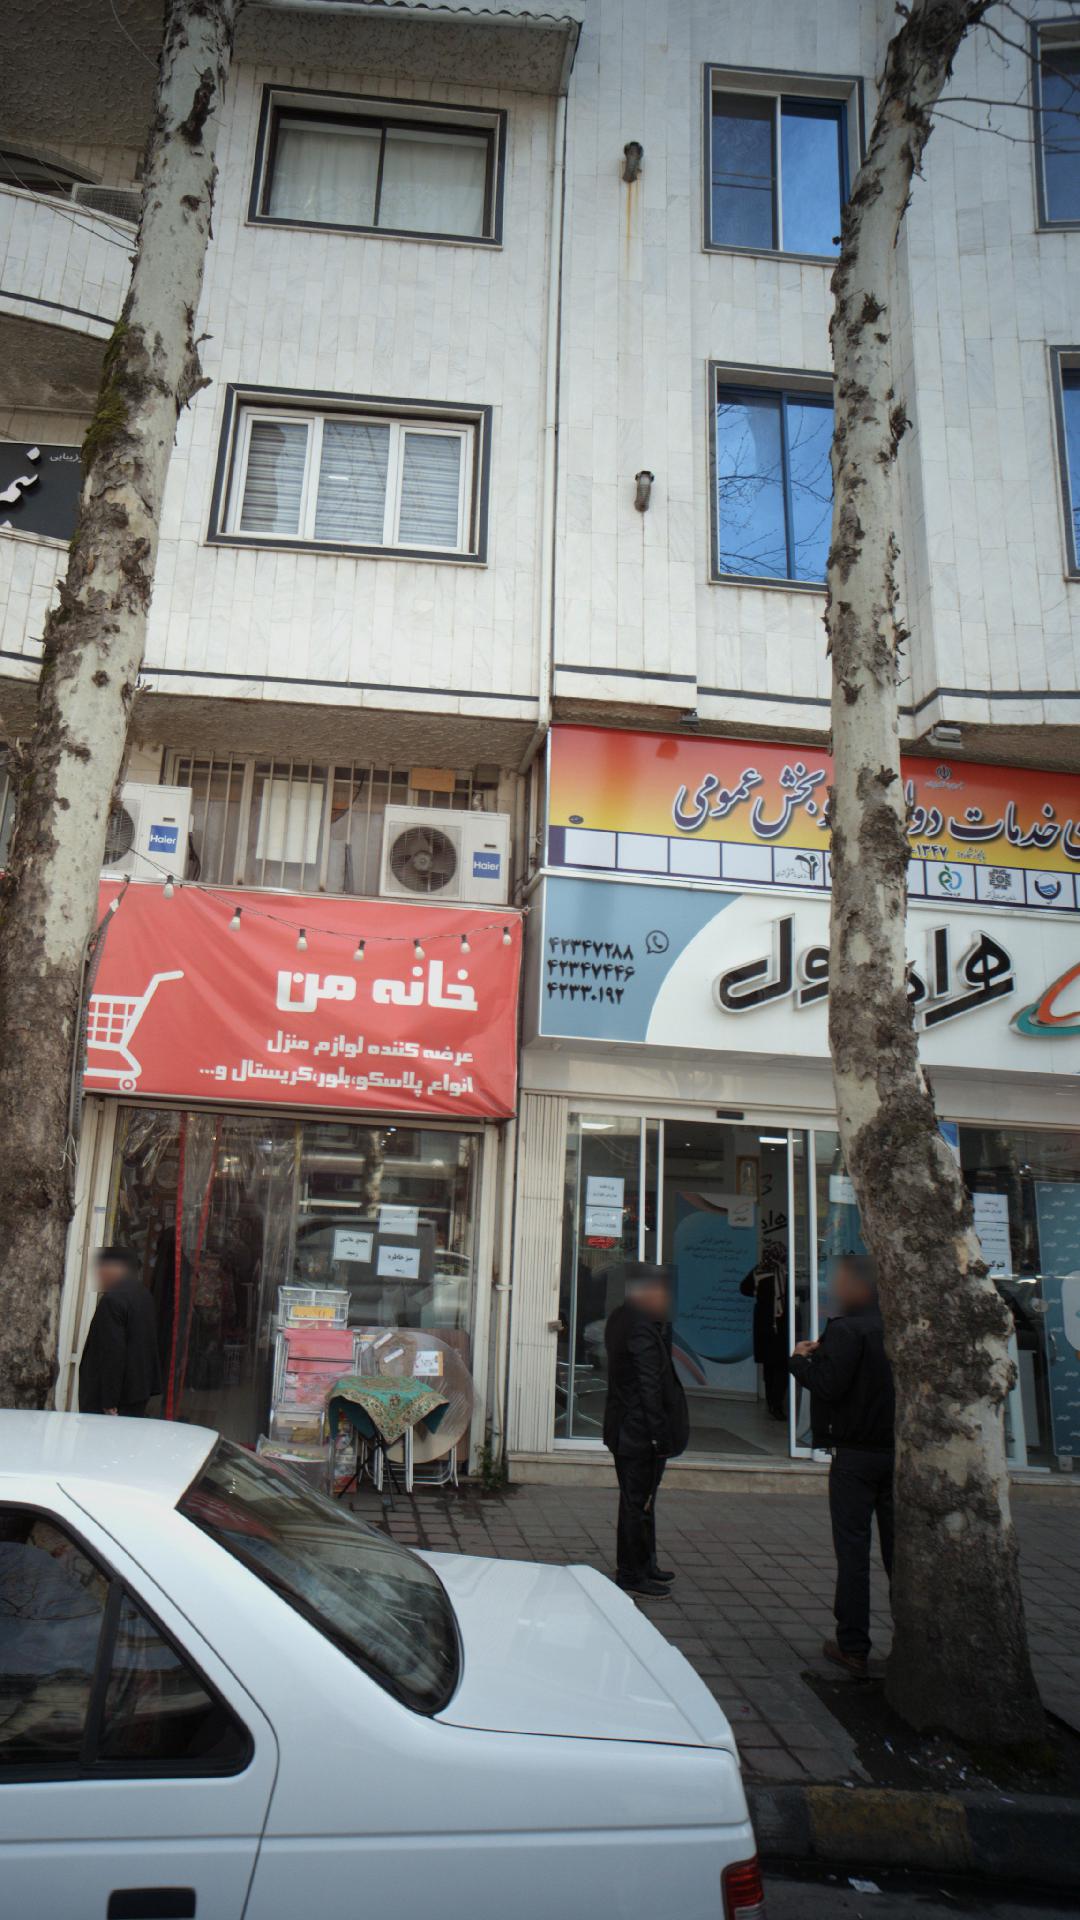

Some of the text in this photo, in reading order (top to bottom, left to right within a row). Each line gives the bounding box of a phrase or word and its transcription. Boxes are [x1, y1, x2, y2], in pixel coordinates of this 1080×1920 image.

[672, 767, 763, 831] عمومی
[750, 761, 826, 838] بخش
[149, 833, 177, 848] Haier
[947, 800, 1061, 848] خدمات
[472, 859, 500, 874] Haier
[276, 959, 479, 1014] خانه من
[266, 1030, 474, 1067] عرضه کننده لوازم منزل
[426, 1073, 474, 1097] انواع
